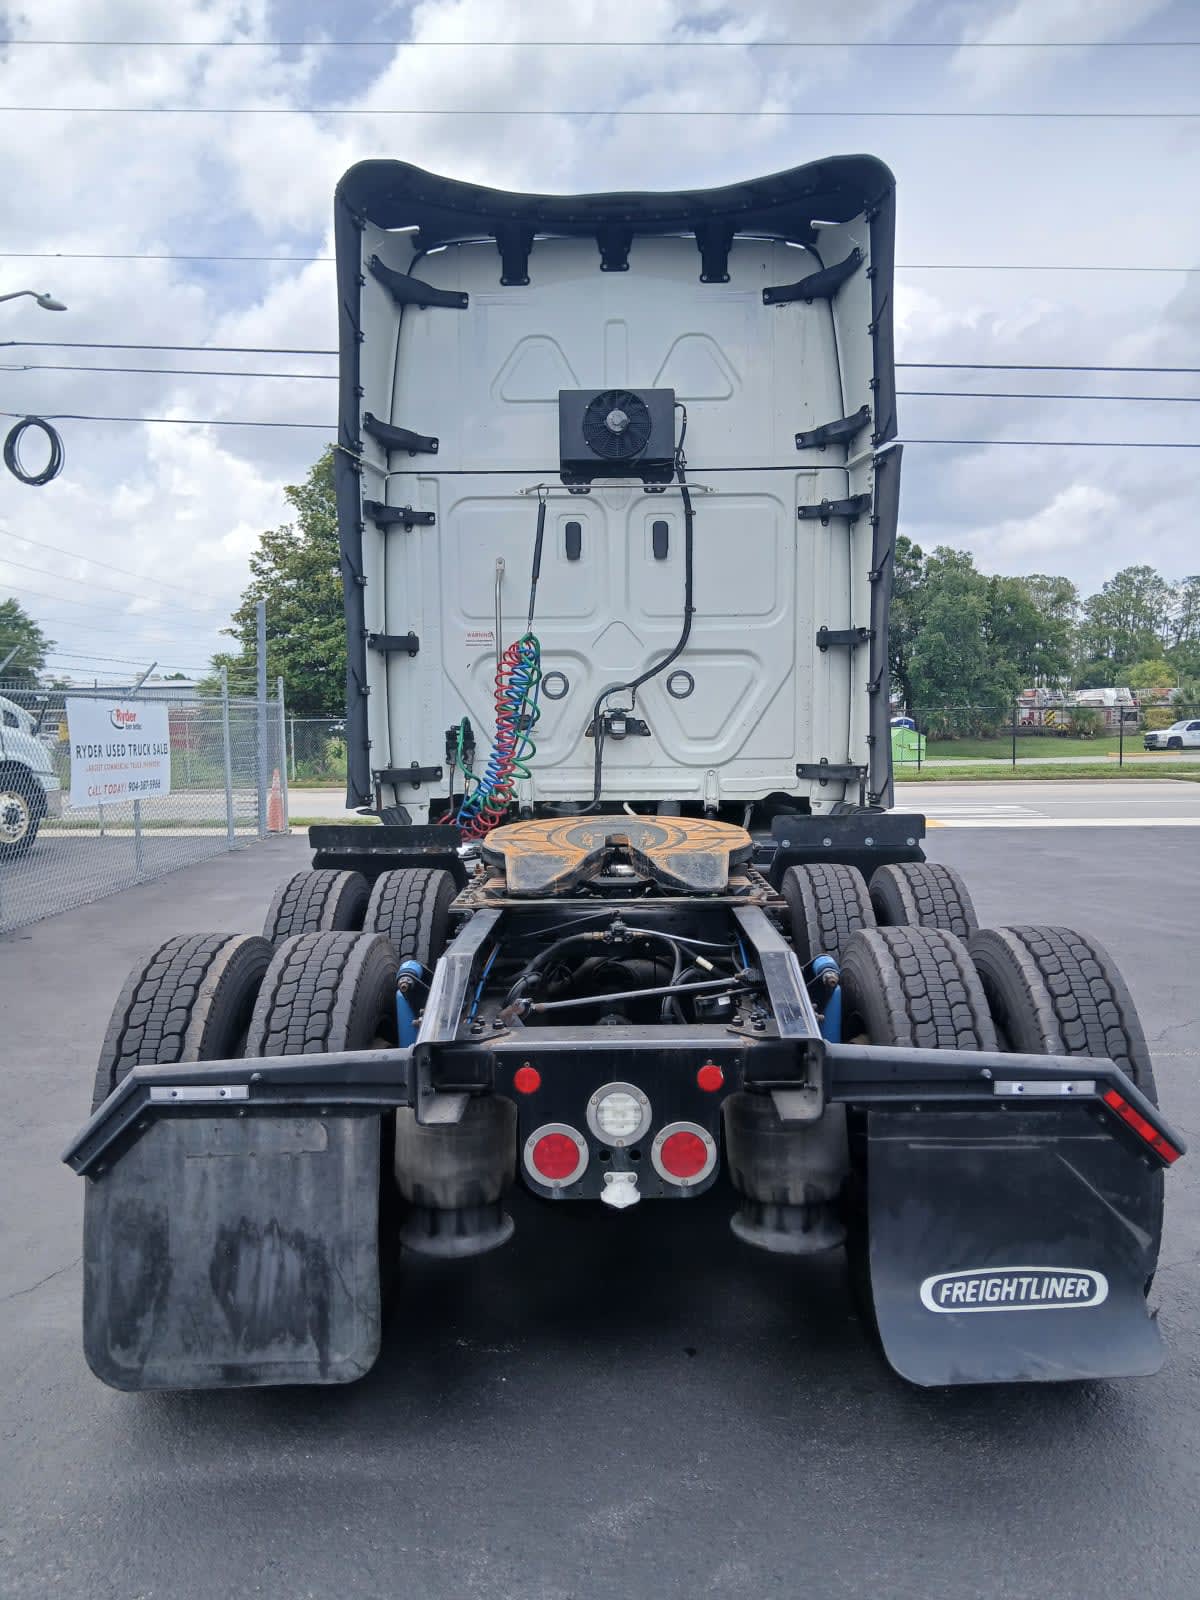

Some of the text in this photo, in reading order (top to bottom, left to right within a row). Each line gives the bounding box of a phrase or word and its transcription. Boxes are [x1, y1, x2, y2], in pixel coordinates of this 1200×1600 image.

[116, 708, 136, 725] Ryder
[76, 744, 103, 759] RYDER
[106, 744, 126, 758] USED
[128, 743, 151, 757] TRUCK
[88, 785, 102, 797] CALL
[104, 783, 127, 794] TODAY!
[940, 1277, 1090, 1303] FREIGHTLINER
